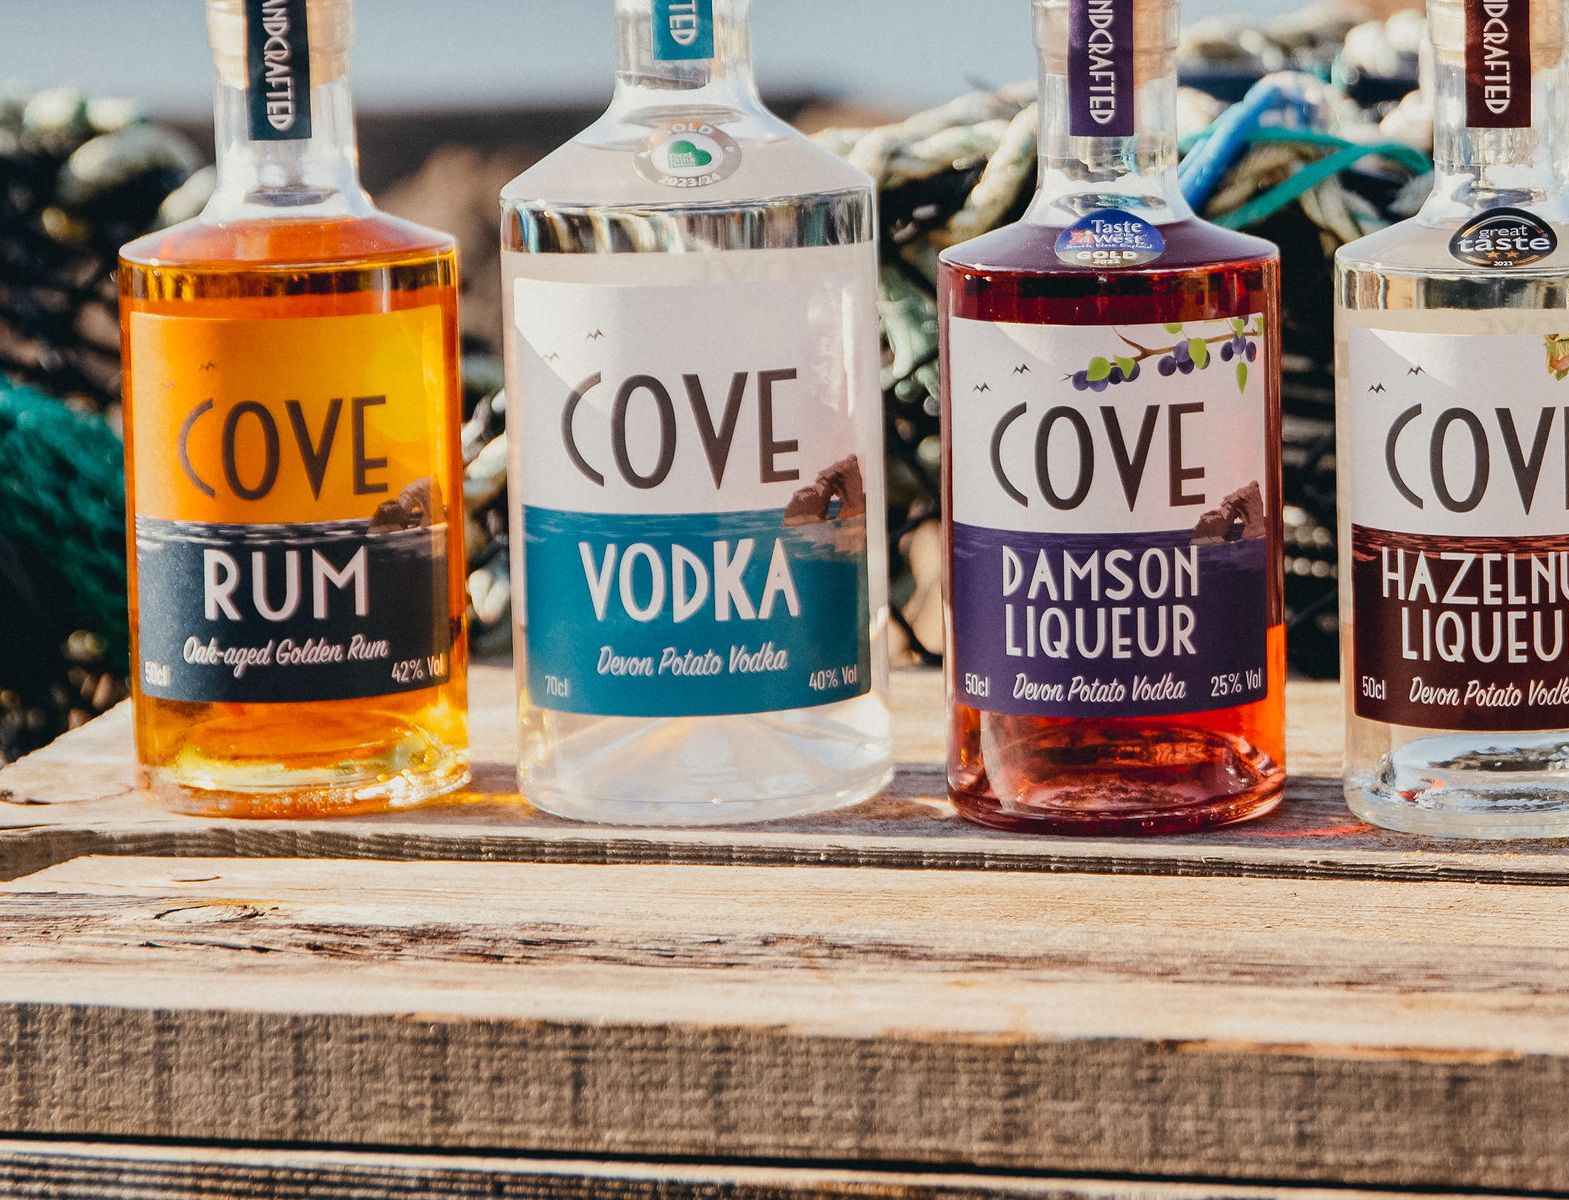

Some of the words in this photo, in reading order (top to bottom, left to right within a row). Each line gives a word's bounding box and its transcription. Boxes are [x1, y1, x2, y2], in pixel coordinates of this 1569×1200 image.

[1091, 220, 1141, 233] Taste
[1094, 234, 1144, 244] West
[1479, 225, 1527, 238] great
[1076, 251, 1137, 259] GOLD
[1457, 237, 1550, 252] taste
[561, 368, 800, 490] COVE
[178, 395, 388, 501] COVE
[990, 401, 1205, 512] COVE
[203, 545, 369, 622] RUM
[578, 537, 799, 623] VODKA
[1002, 545, 1199, 601] DAMSON
[1005, 603, 1197, 659] LIQUEUR
[183, 636, 271, 679] Oak-aged
[275, 640, 343, 665] Golden
[348, 634, 390, 660] Rum
[391, 658, 423, 683] 42%
[427, 653, 444, 675] Vol
[597, 645, 654, 676] Devon
[658, 646, 724, 676] Potato
[728, 641, 788, 672] Vodka
[545, 675, 568, 697] 70cl
[809, 669, 838, 690] 40%
[842, 666, 857, 684] Vol
[965, 673, 989, 697] 50cl
[1012, 672, 1064, 702] Devon
[1067, 676, 1125, 702] Potato
[1132, 672, 1186, 701] Vodka
[1210, 672, 1241, 697] 25%
[1245, 668, 1262, 690] Vol
[1362, 676, 1386, 700] 50cl
[1409, 676, 1459, 706] Devon
[1464, 679, 1523, 707] Potato
